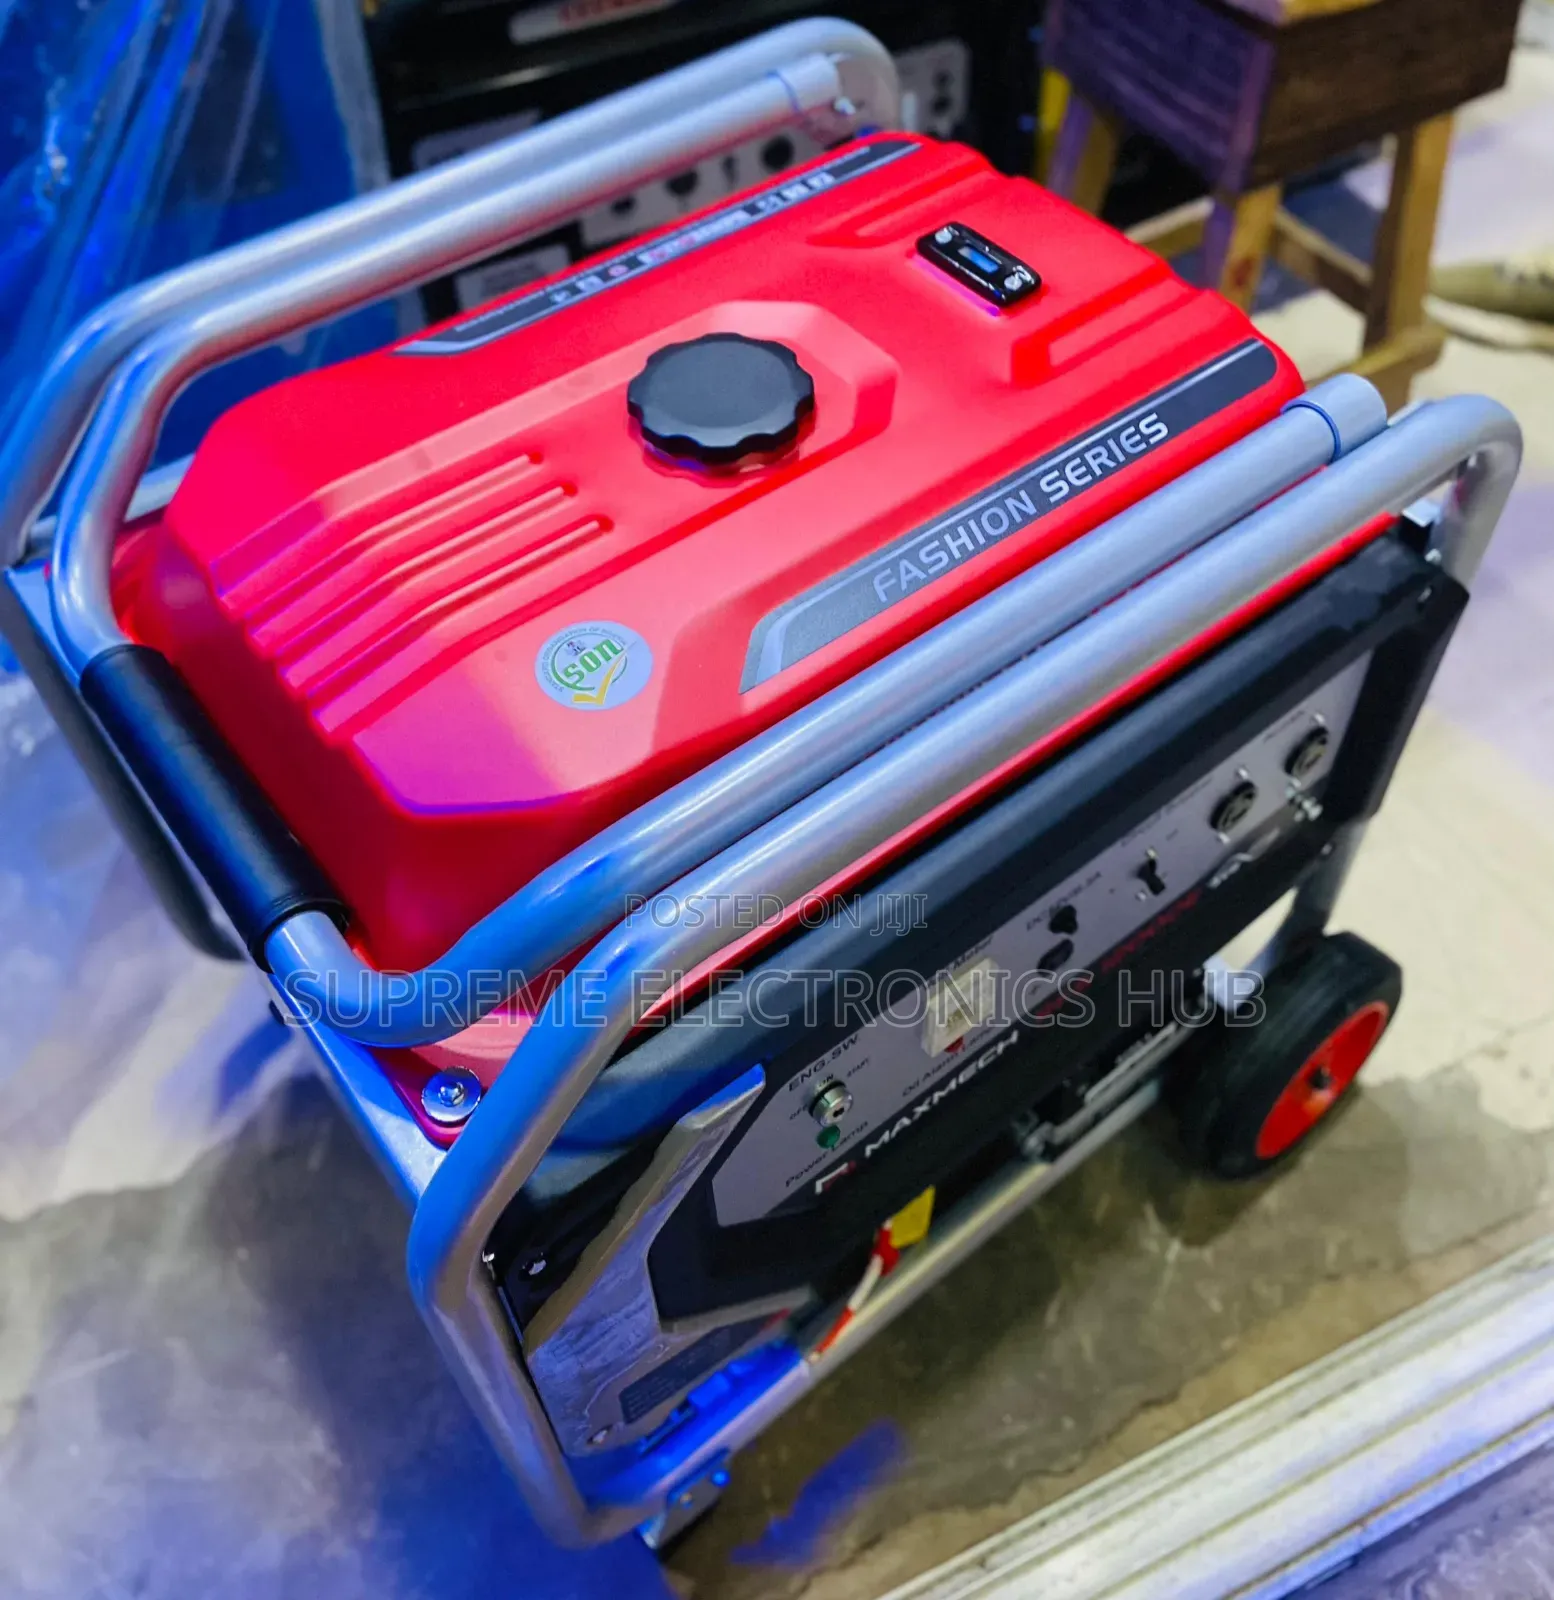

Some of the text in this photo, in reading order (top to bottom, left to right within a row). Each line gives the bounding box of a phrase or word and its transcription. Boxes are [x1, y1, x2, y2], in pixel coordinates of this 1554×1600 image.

[872, 412, 1169, 602] FASHION SERIES
[789, 1033, 859, 1092] ENG.SW
[864, 1029, 1019, 1158] MAXMECH
[785, 1150, 829, 1188] Power
